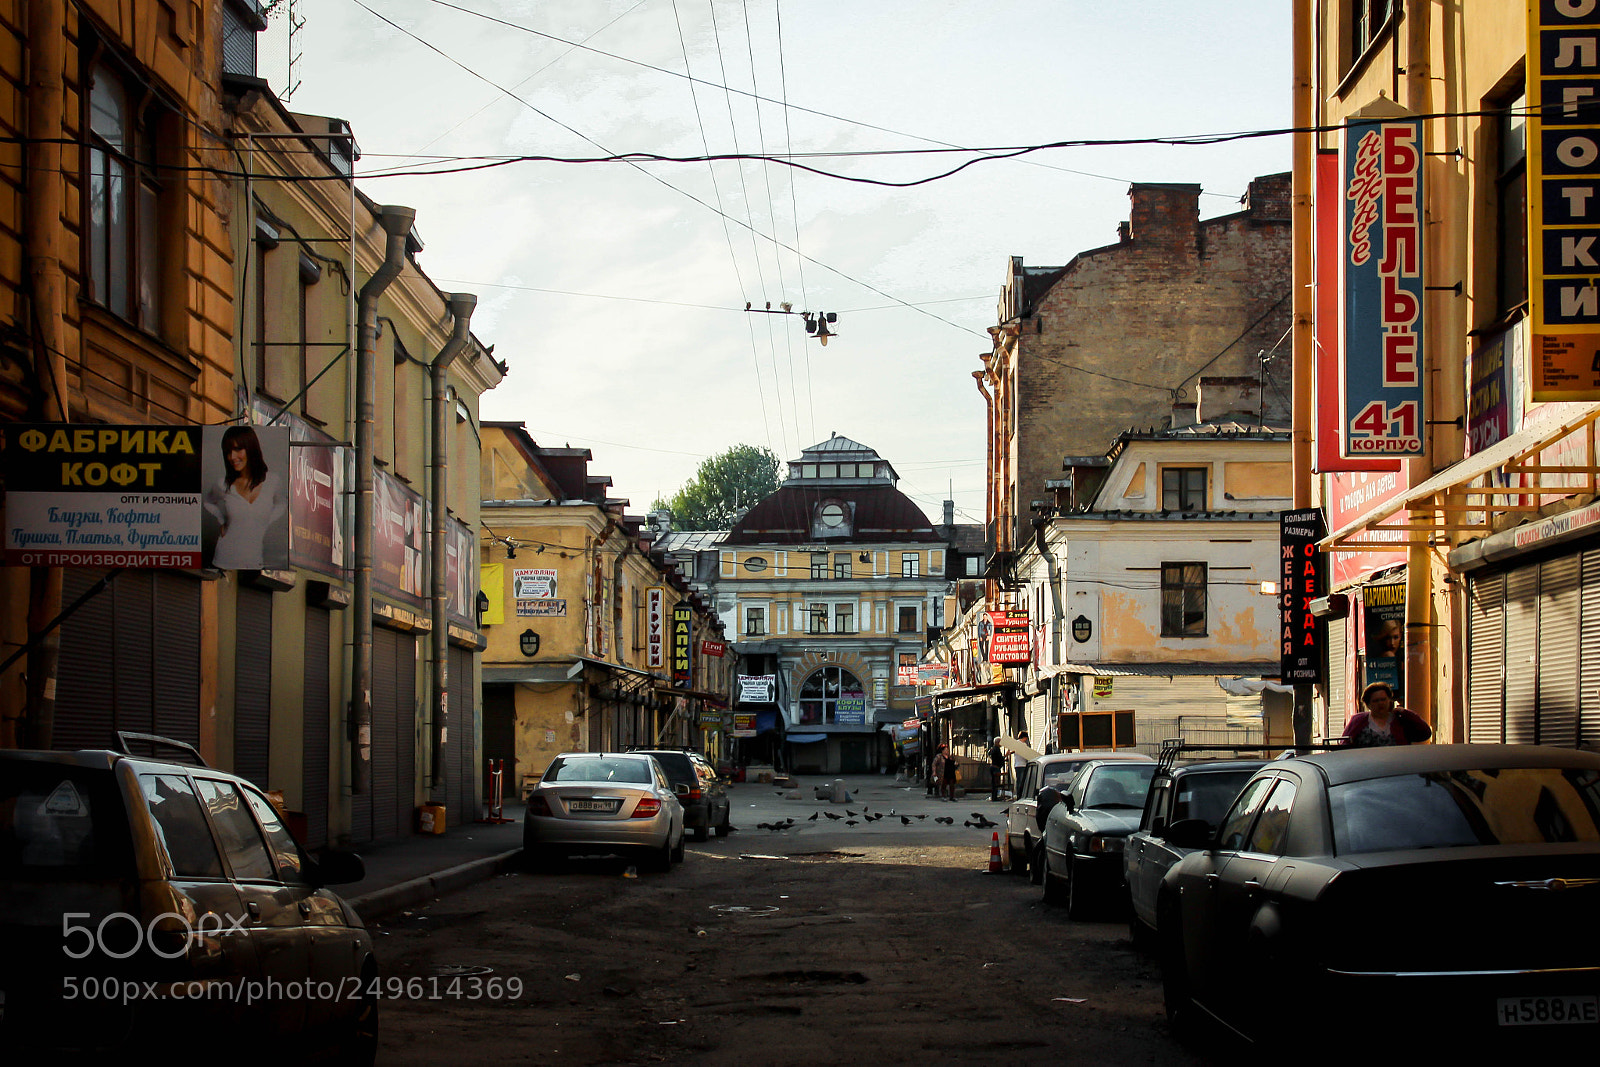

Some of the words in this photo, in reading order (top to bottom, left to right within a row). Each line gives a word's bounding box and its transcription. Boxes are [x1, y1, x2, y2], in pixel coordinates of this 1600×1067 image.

[1380, 126, 1418, 384] БЕЛЬЁ
[1353, 402, 1415, 436] 41
[19, 429, 195, 454] ФАБРИКА
[1351, 438, 1419, 451] КОРПУС
[61, 462, 162, 487] КОФТ
[120, 495, 140, 505] ОПТ
[142, 495, 150, 504] И
[152, 495, 198, 505] РОЗНИЦА
[106, 506, 160, 525] Кофты
[1284, 512, 1316, 523] БОЛЬШИЕ
[128, 529, 199, 549] Футболки
[1284, 527, 1314, 538] РАЗМЕРЫ
[1516, 527, 1540, 547] ХАЛАТЫ
[22, 553, 43, 565] ОТ
[48, 553, 192, 567] ПРОИЗВОДИТЕЛЯ
[1282, 544, 1294, 655] ЖЕНСКАЯ
[1303, 543, 1317, 646] ОДЕЖДА
[649, 591, 661, 666] ИГРУШКИ
[674, 610, 690, 670] ШАПКИ
[994, 644, 1028, 652] РУБАШКИ
[996, 635, 1028, 643] СВИТЕРА
[992, 652, 1028, 661] ТОЛСТОВКИ
